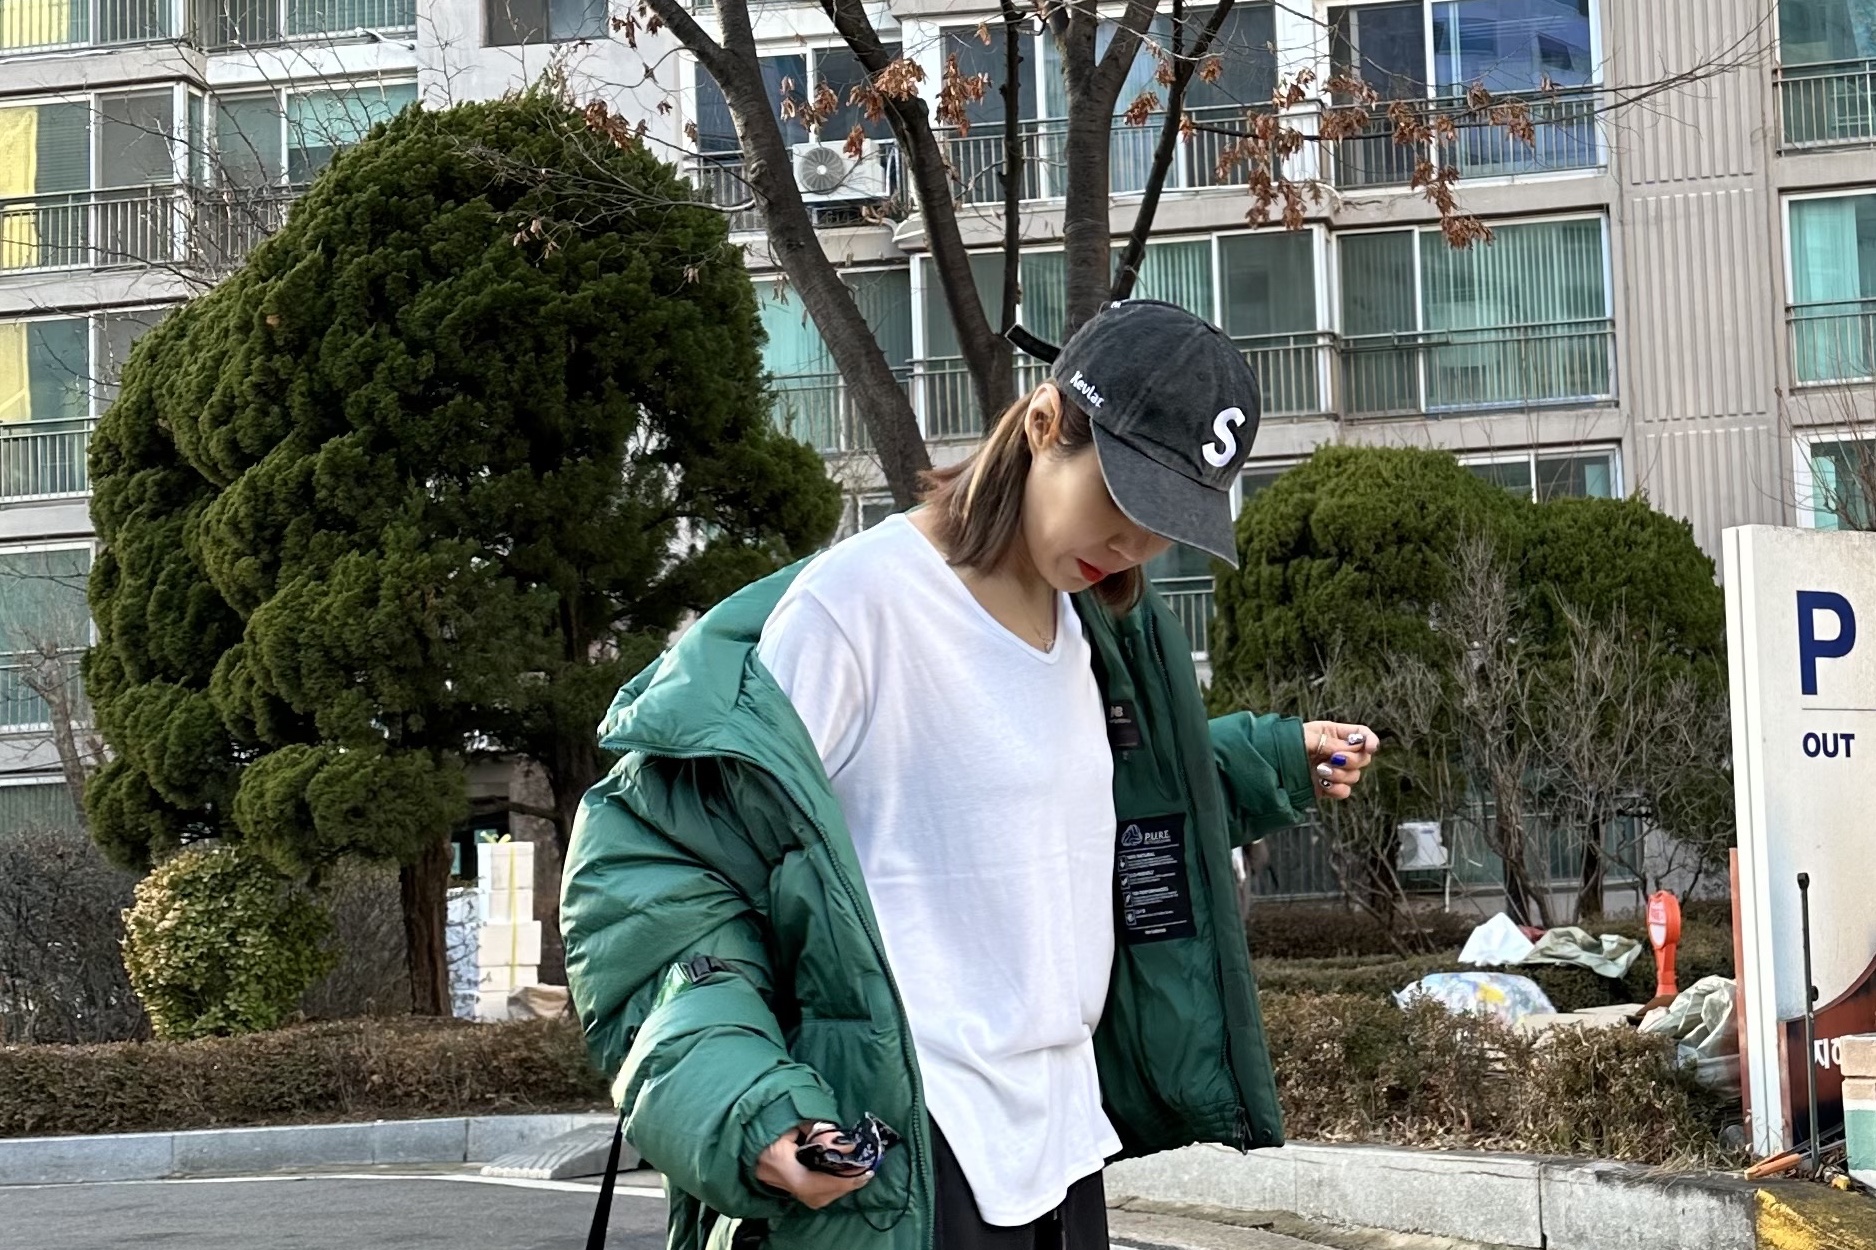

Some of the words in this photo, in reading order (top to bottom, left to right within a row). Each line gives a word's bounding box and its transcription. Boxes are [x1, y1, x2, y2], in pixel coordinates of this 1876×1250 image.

[1201, 407, 1246, 467] S
[1796, 590, 1856, 695] P
[1803, 732, 1855, 758] OUT
